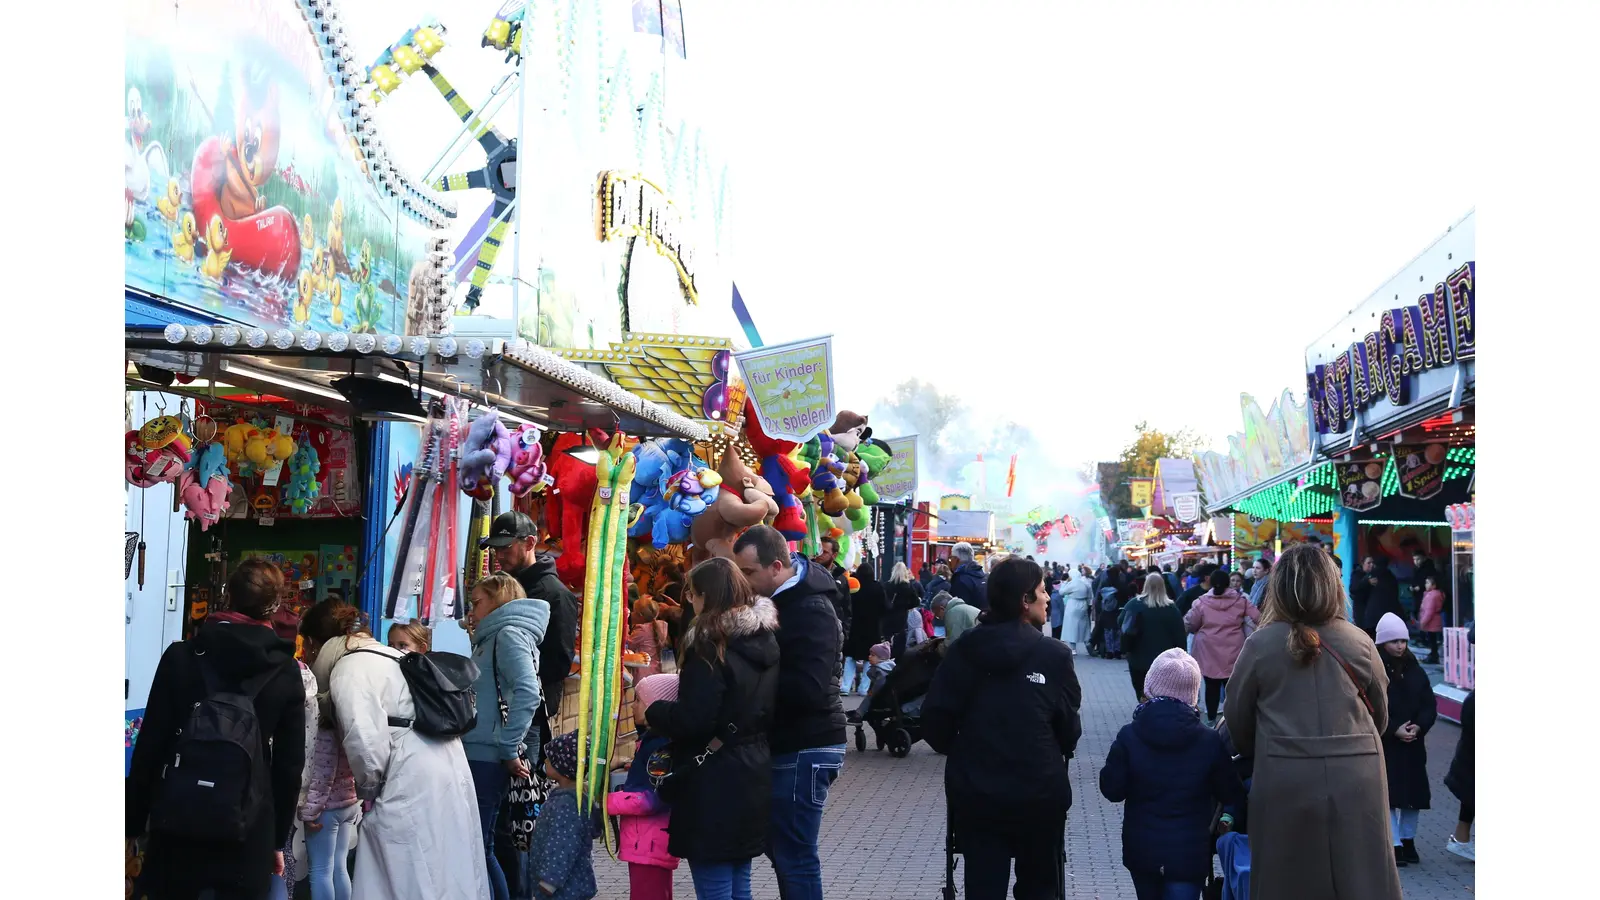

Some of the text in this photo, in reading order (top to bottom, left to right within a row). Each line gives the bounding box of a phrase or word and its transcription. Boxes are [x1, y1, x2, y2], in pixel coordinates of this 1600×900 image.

[752, 361, 823, 385] für Kinder:
[764, 403, 830, 433] 2x spielen!
